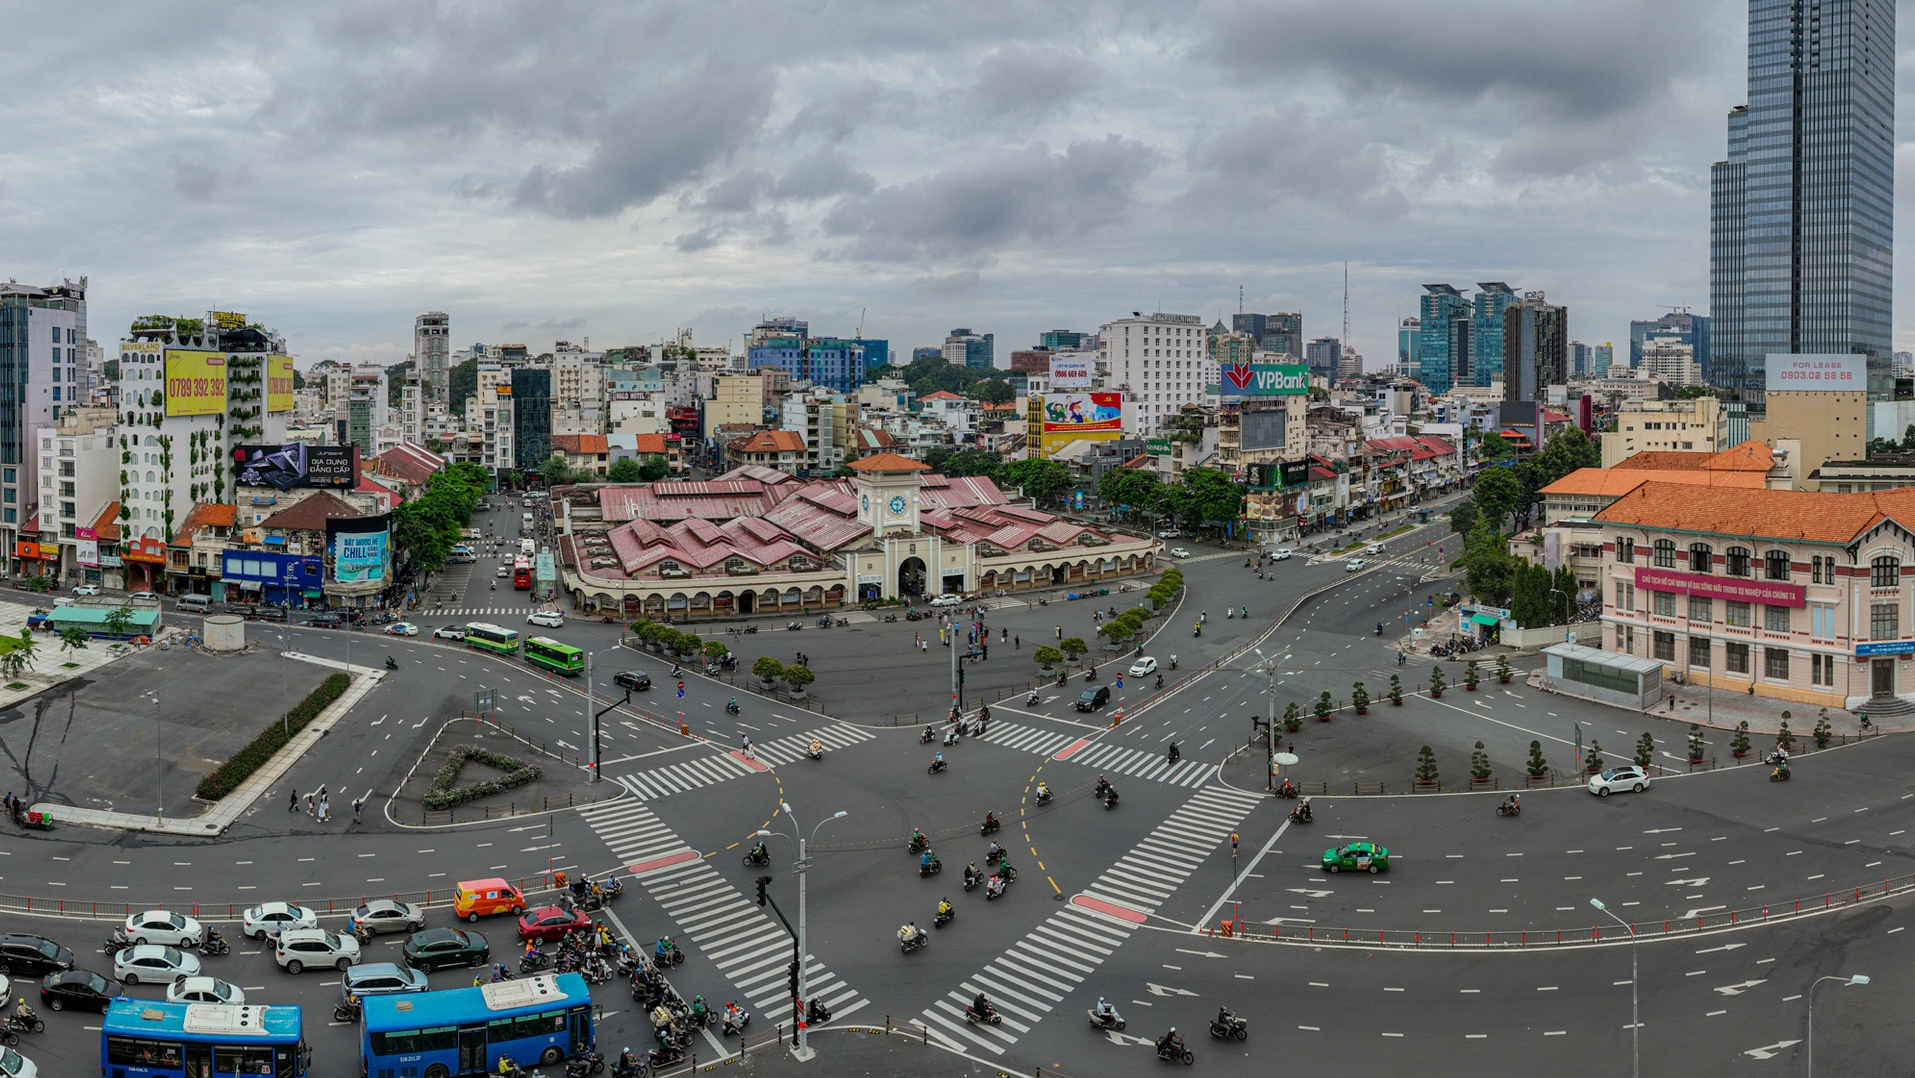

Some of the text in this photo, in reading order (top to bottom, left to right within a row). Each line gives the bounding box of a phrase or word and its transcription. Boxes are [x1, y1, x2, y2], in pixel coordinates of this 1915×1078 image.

[1256, 371, 1306, 390] VPBank
[1781, 371, 1852, 380] 0903.02 58 58
[170, 378, 224, 398] 0789 392 392
[344, 547, 366, 558] CHILL
[1642, 574, 1650, 582] CHỦ
[1652, 577, 1660, 585] TỊCH
[1662, 576, 1668, 584] HỒ
[1676, 580, 1687, 588] MINH
[1688, 580, 1692, 588] VĨ
[1701, 582, 1712, 592] SỐNG
[1714, 584, 1722, 592] MÃI
[1723, 586, 1738, 594] TRONG
[1738, 587, 1744, 596] SỰ
[1745, 588, 1762, 598] NGHIỆP
[1762, 588, 1772, 598] CỦA
[1772, 590, 1788, 600] CHÚNG
